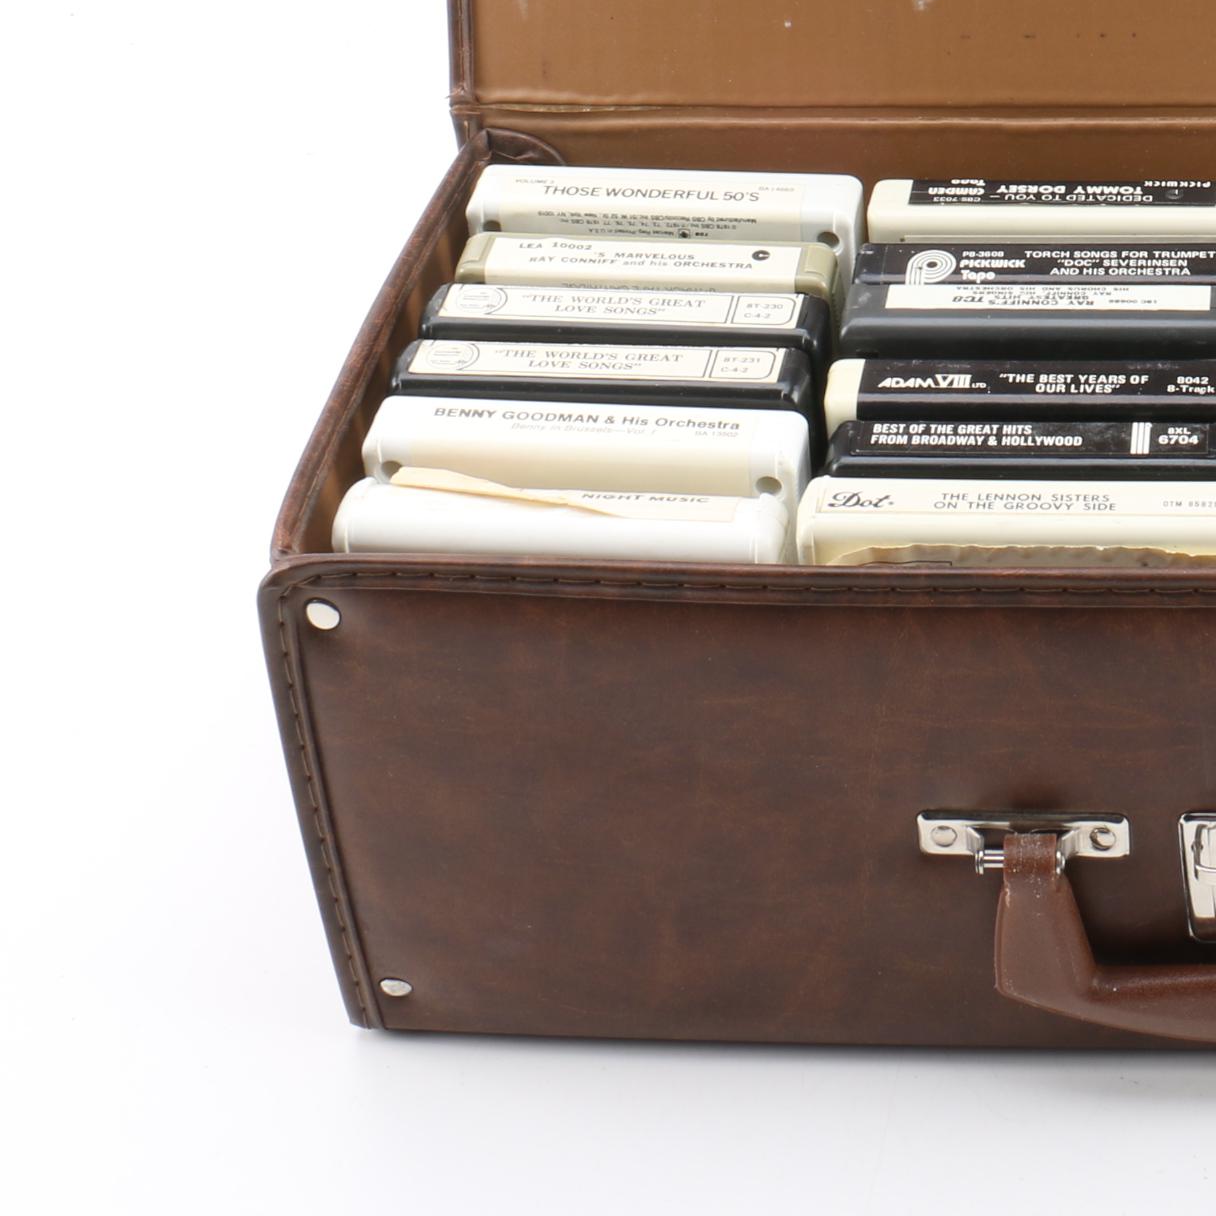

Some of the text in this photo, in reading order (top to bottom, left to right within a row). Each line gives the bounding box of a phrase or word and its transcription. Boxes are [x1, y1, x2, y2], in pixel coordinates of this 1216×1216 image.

[1144, 180, 1212, 188] PICKWICK
[543, 185, 760, 202] THOSE WONDERFUL 50'S
[996, 184, 1144, 195] TOMMY DORSEY
[1005, 193, 1153, 202] DEDICATED TO YOU
[552, 241, 593, 251] 10002
[614, 251, 696, 261] MARVELOUS
[1024, 250, 1216, 259] TORCH SONGS FOR TRUMPET
[560, 256, 619, 265] CONNIFF
[623, 259, 646, 267] and
[650, 259, 669, 267] his
[674, 260, 753, 270] ORCHESTRA
[959, 259, 1026, 269] PICKWICK
[1103, 259, 1188, 268] SEVERINSEN
[960, 269, 996, 284] Tape
[1050, 267, 1191, 276] AND HIS ORCHESTRA
[571, 296, 643, 306] WORLD'S
[649, 298, 706, 308] GREAT
[555, 305, 597, 314] LOVE
[545, 350, 618, 361] WORLD'S
[624, 353, 684, 363] GREAT
[528, 360, 571, 369] LOVE
[877, 377, 935, 388] ADAM
[1039, 374, 1074, 384] BEST
[1078, 374, 1127, 384] YEARS
[1129, 375, 1149, 384] OF
[1176, 376, 1209, 385] 8042
[1035, 384, 1066, 393] OUR
[434, 407, 740, 430] BENNY GOODMAN & His Orchestra
[873, 423, 1033, 435] BEST OF THE GREAT HITS
[870, 434, 1083, 446] FROM BROADWAY & HOLLYWOOD
[1158, 435, 1199, 445] 6704
[582, 492, 711, 504] NIGHT MUSIC
[941, 492, 1111, 503] THE LENNON SISTERS
[933, 501, 1117, 511] ON THE GROOVY SIDE
